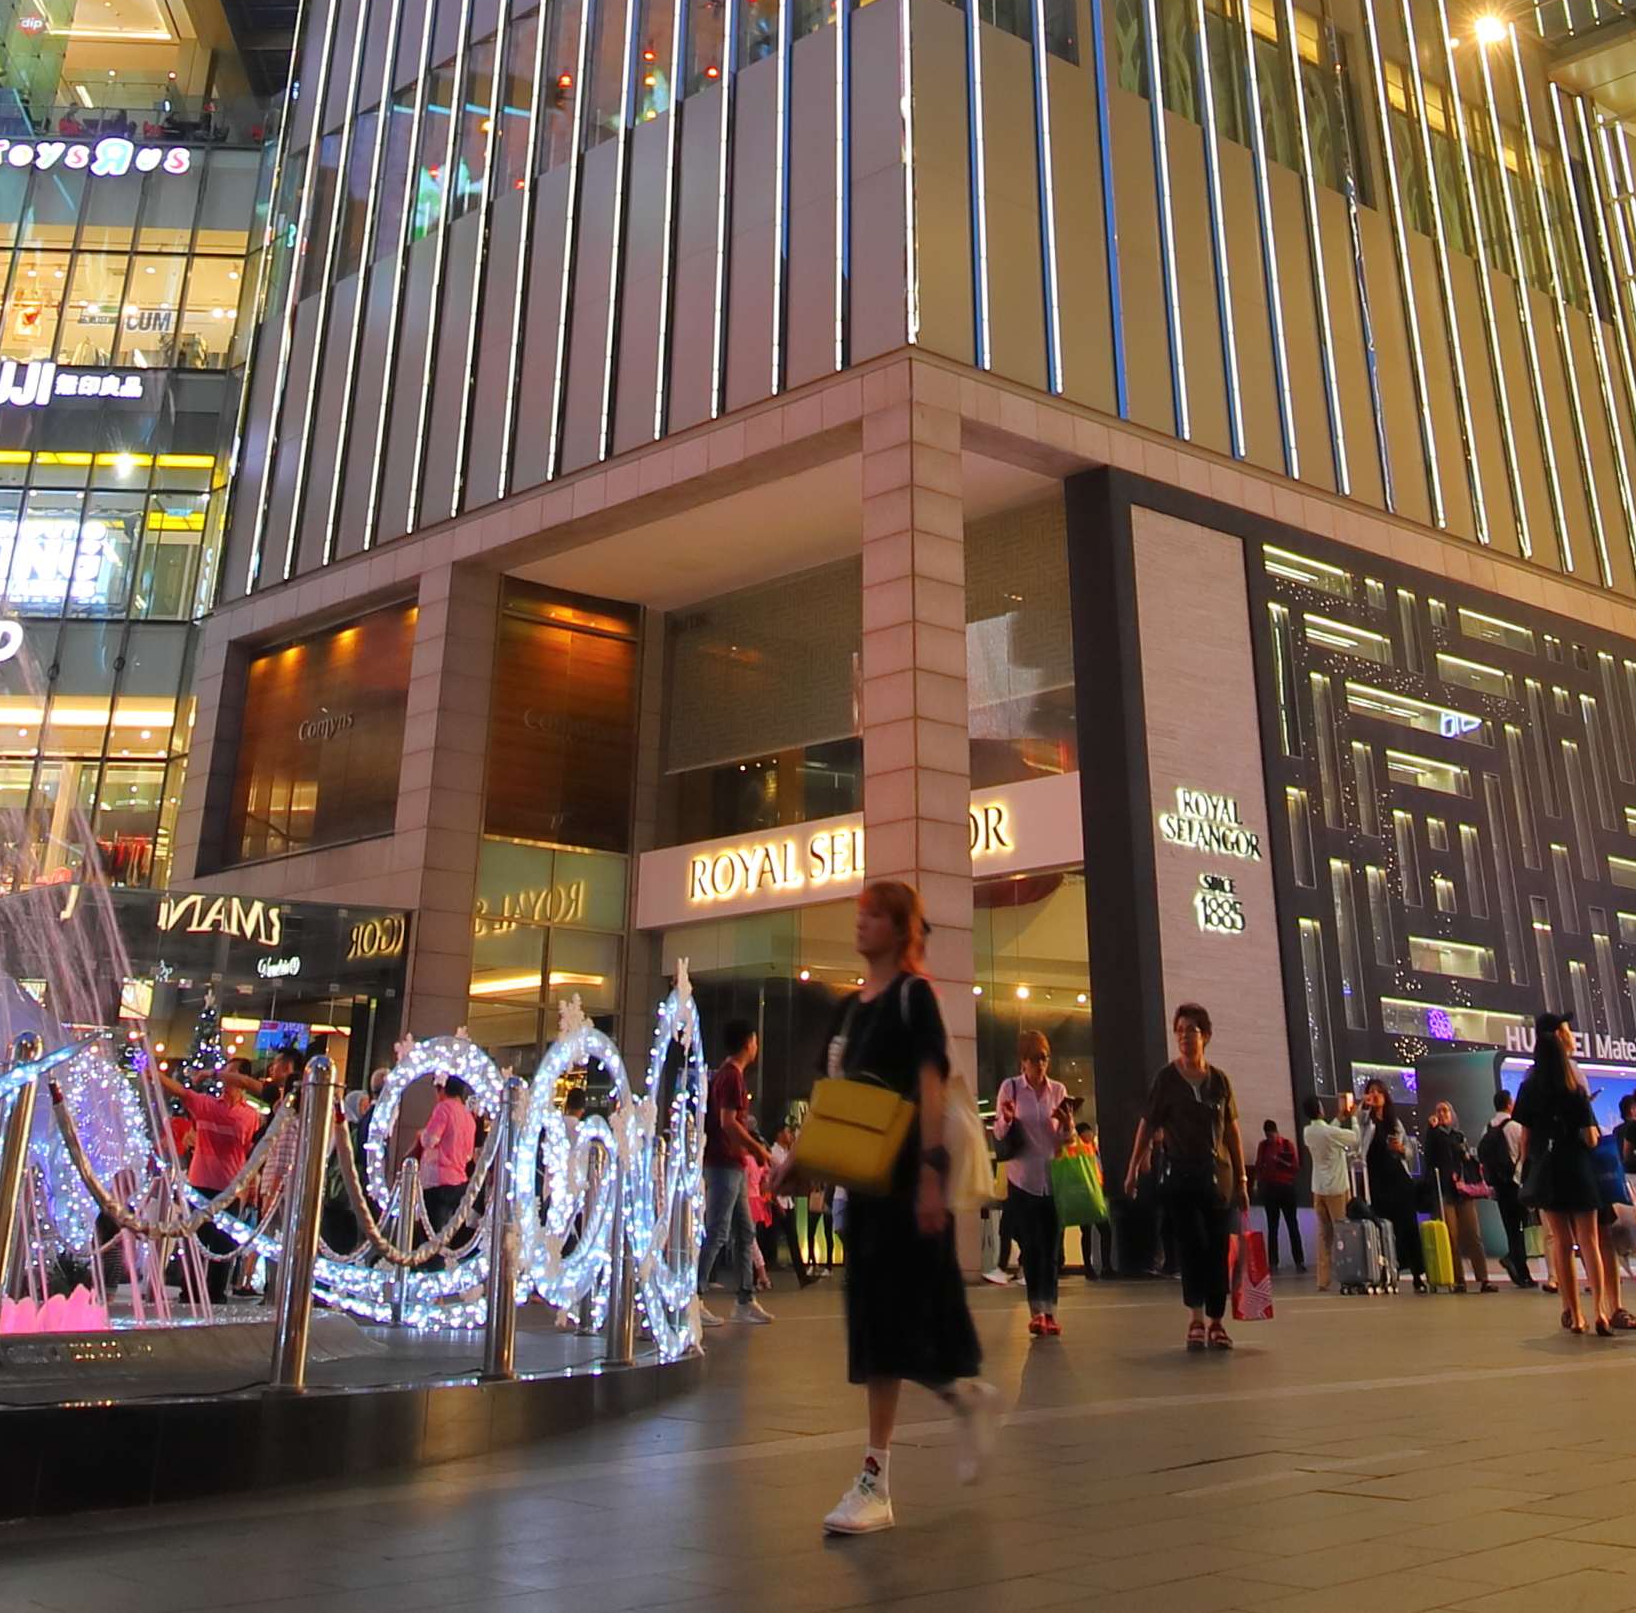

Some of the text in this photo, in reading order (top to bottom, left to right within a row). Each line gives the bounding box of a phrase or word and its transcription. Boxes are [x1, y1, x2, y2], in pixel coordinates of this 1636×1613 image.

[1175, 786, 1243, 828] ROYAL
[688, 841, 802, 901] ROYAL
[1198, 894, 1247, 933] 1885
[1504, 1024, 1592, 1059] HUEI
